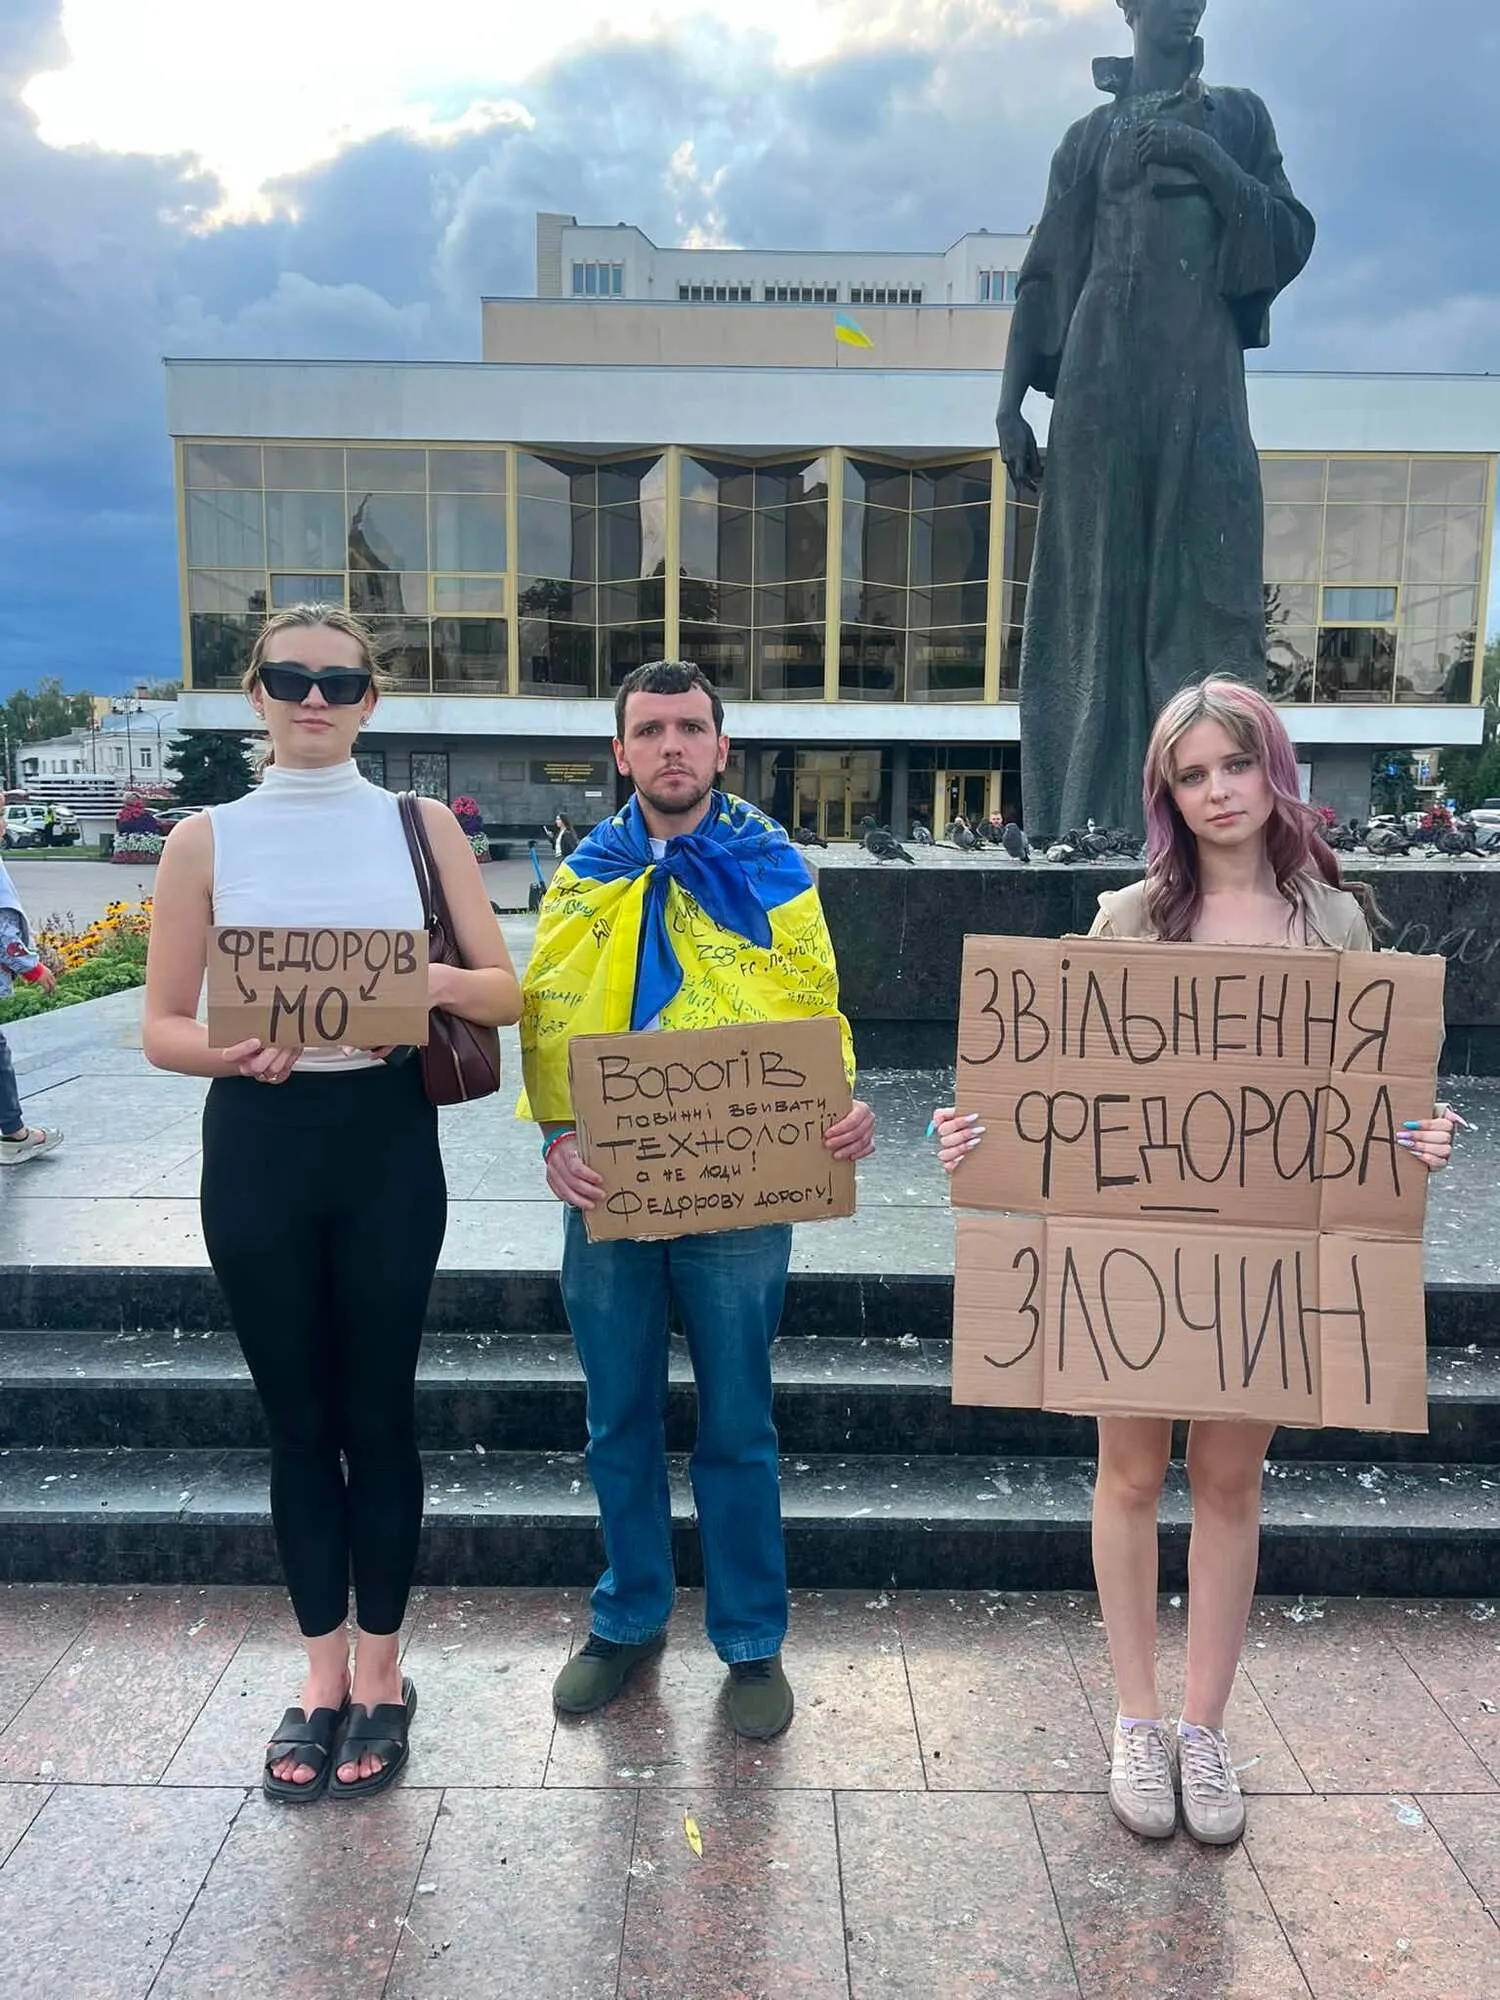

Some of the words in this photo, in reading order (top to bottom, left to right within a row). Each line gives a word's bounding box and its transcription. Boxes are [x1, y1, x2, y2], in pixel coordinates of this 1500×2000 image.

[217, 929, 417, 975] ФЕДОРОВ
[270, 985, 349, 1044] МО
[960, 958, 1396, 1073] ЗВІЛЬНЕННЯ
[728, 1098, 826, 1120] ВБИВАТИ
[1014, 1085, 1401, 1199] ФЕДОРОВА
[606, 1187, 745, 1223] ФЕДОРОВУ
[753, 1171, 833, 1207] ДОРОГУ!
[662, 1167, 686, 1183] НЕ
[984, 1247, 1371, 1404] ЗЛОЧИН
